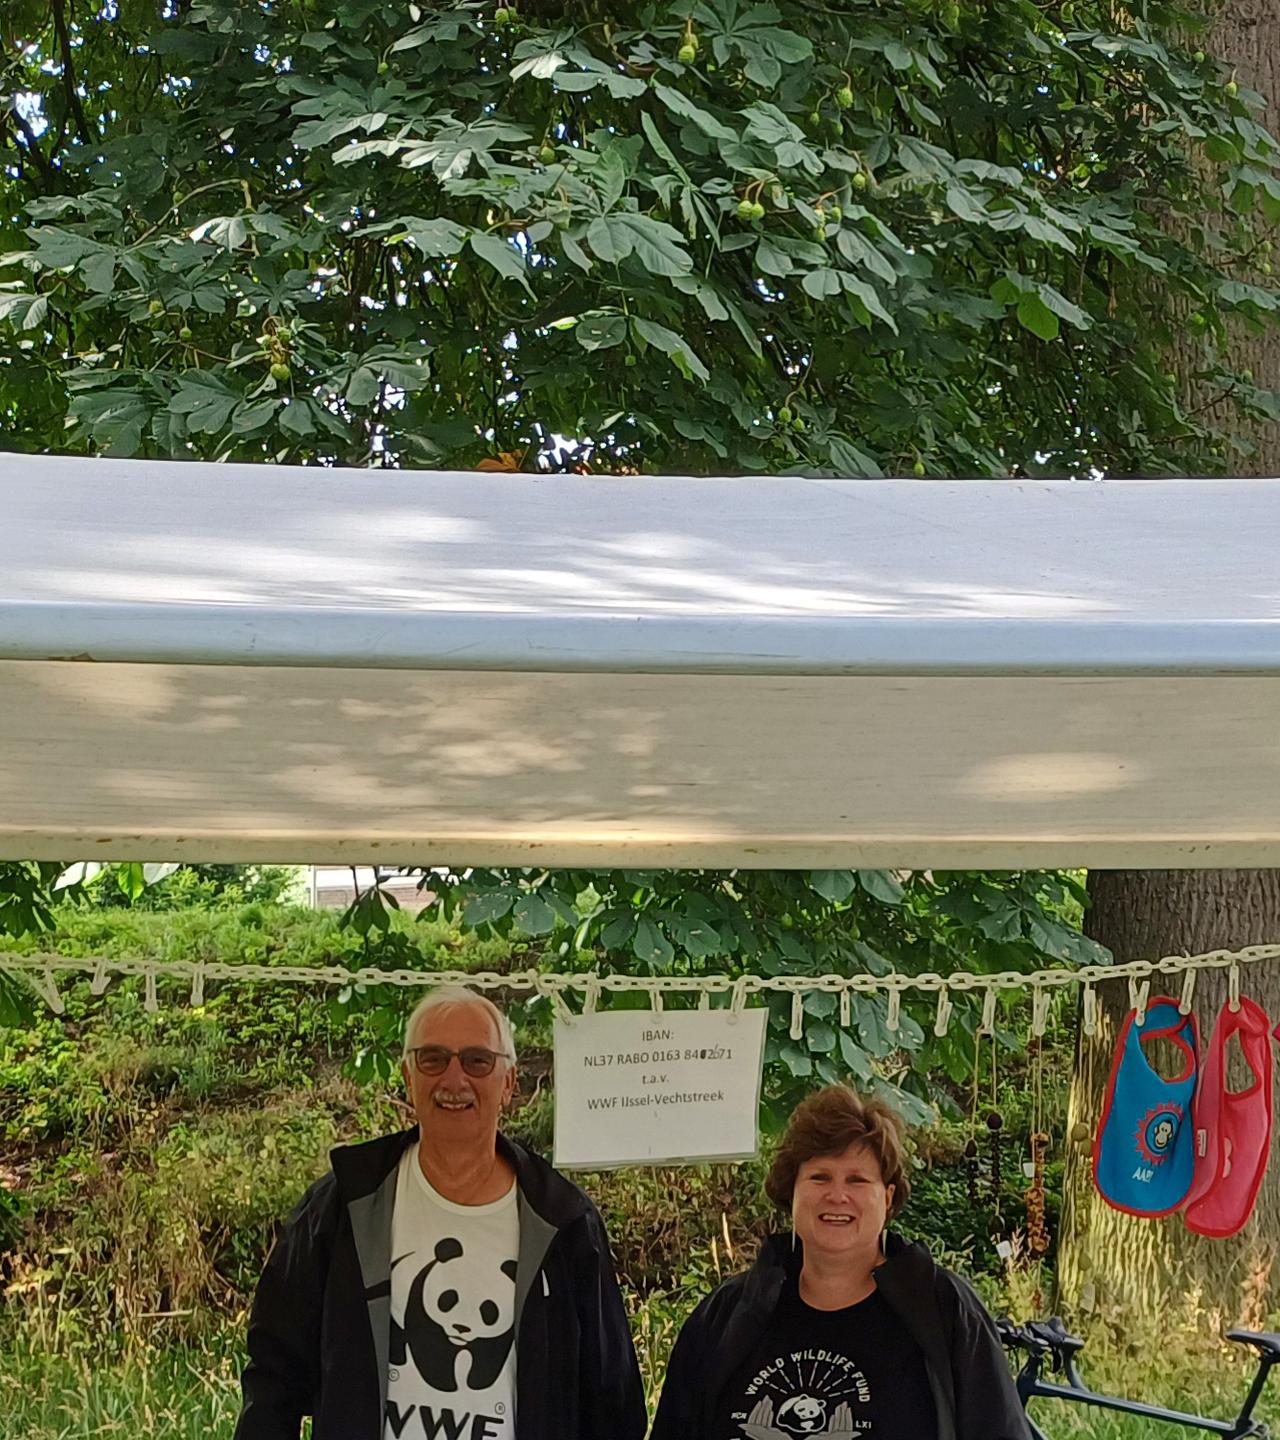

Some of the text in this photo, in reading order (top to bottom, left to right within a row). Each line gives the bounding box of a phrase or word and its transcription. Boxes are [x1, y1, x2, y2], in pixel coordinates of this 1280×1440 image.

[642, 1030, 674, 1042] IBAN:
[584, 1054, 613, 1067] NL37
[617, 1052, 649, 1065] RABO
[652, 1050, 680, 1062] 0163
[587, 1090, 724, 1110] WWF IJssel-Vechtstreek
[745, 1349, 871, 1403] WORLD WILDLIFE FUND
